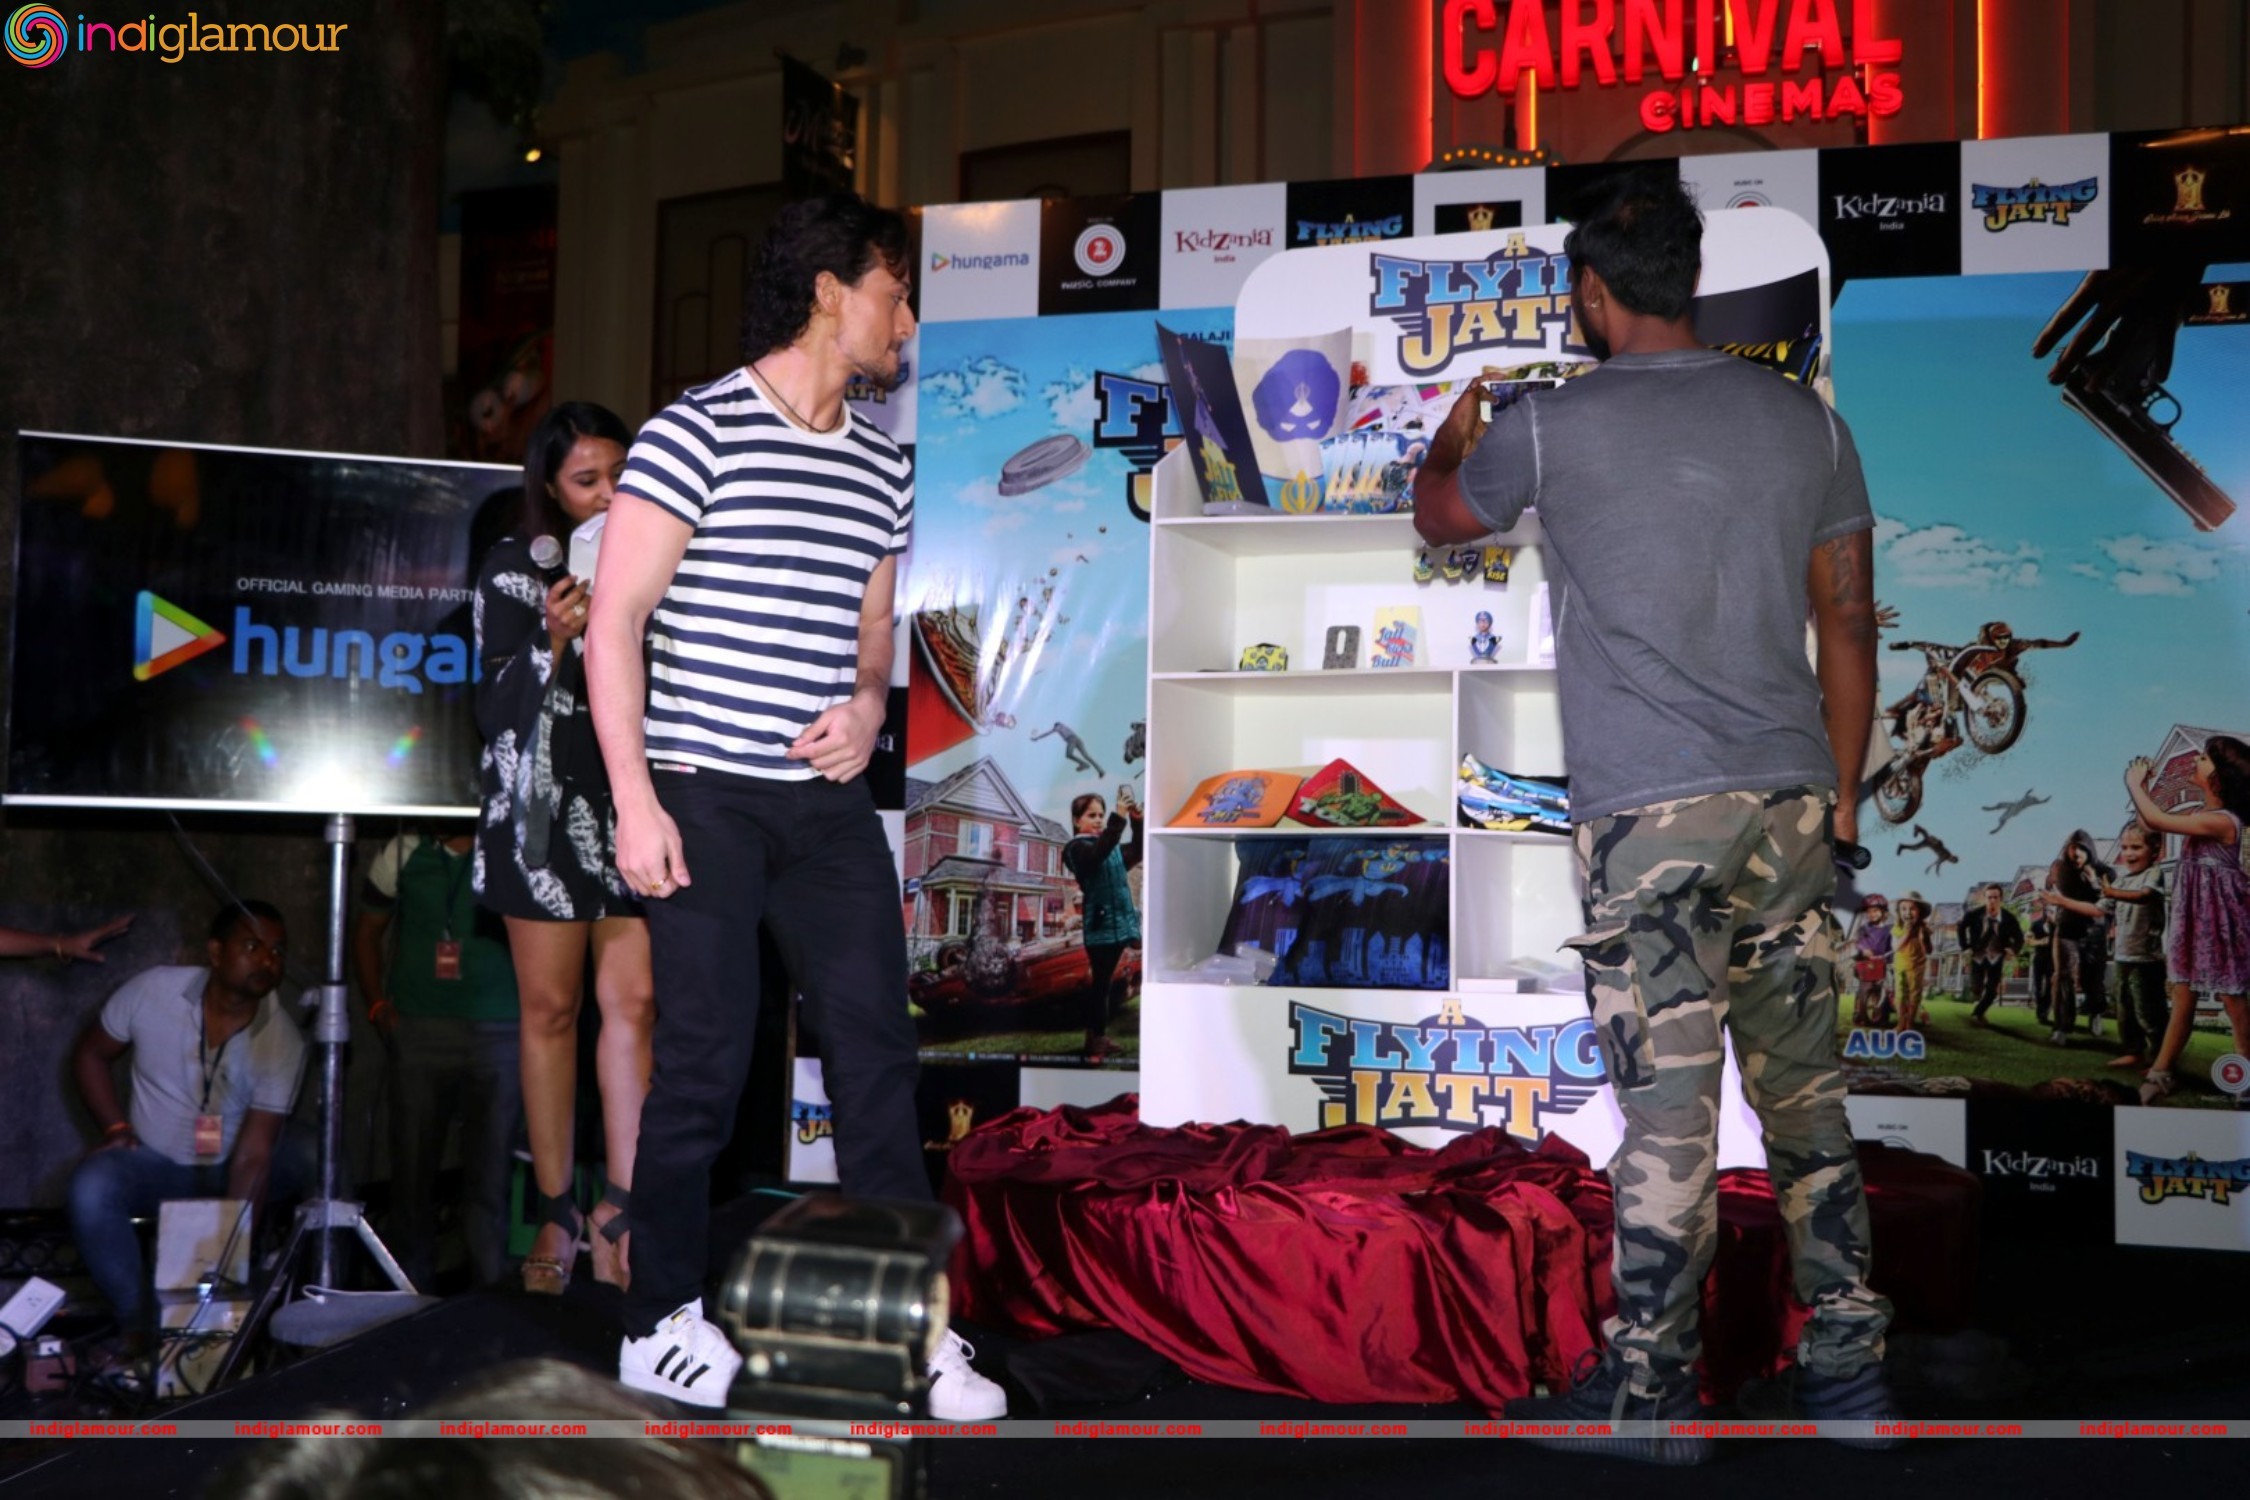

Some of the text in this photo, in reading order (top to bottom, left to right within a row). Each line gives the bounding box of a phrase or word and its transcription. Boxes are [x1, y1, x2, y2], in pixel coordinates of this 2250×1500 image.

[1443, 0, 1902, 96] CARNIVAL
[1640, 73, 1903, 132] CINEMAS
[1834, 193, 1945, 219] KidZania
[1972, 176, 2098, 207] FLYING
[1297, 214, 1402, 241] FLYING
[1879, 220, 1904, 231] India
[1984, 202, 2070, 232] JATT
[1174, 228, 1272, 253] KidZania
[1504, 234, 1528, 257] A
[951, 250, 1030, 270] hungama
[1097, 278, 1136, 288] COMPANY
[1370, 251, 1572, 309] FLYI
[237, 577, 307, 594] OFFICIAL
[312, 581, 373, 598] GAMING
[377, 584, 424, 600] MEDIA
[233, 605, 483, 694] hunga
[1438, 998, 1465, 1026] A
[1294, 1004, 1607, 1080] FLYING
[1843, 1029, 1926, 1060] AUG
[1324, 1070, 1550, 1142] JATT
[1981, 1149, 2099, 1178] KidZania
[2029, 1182, 2056, 1191] India
[2140, 1175, 2231, 1206] JATT
